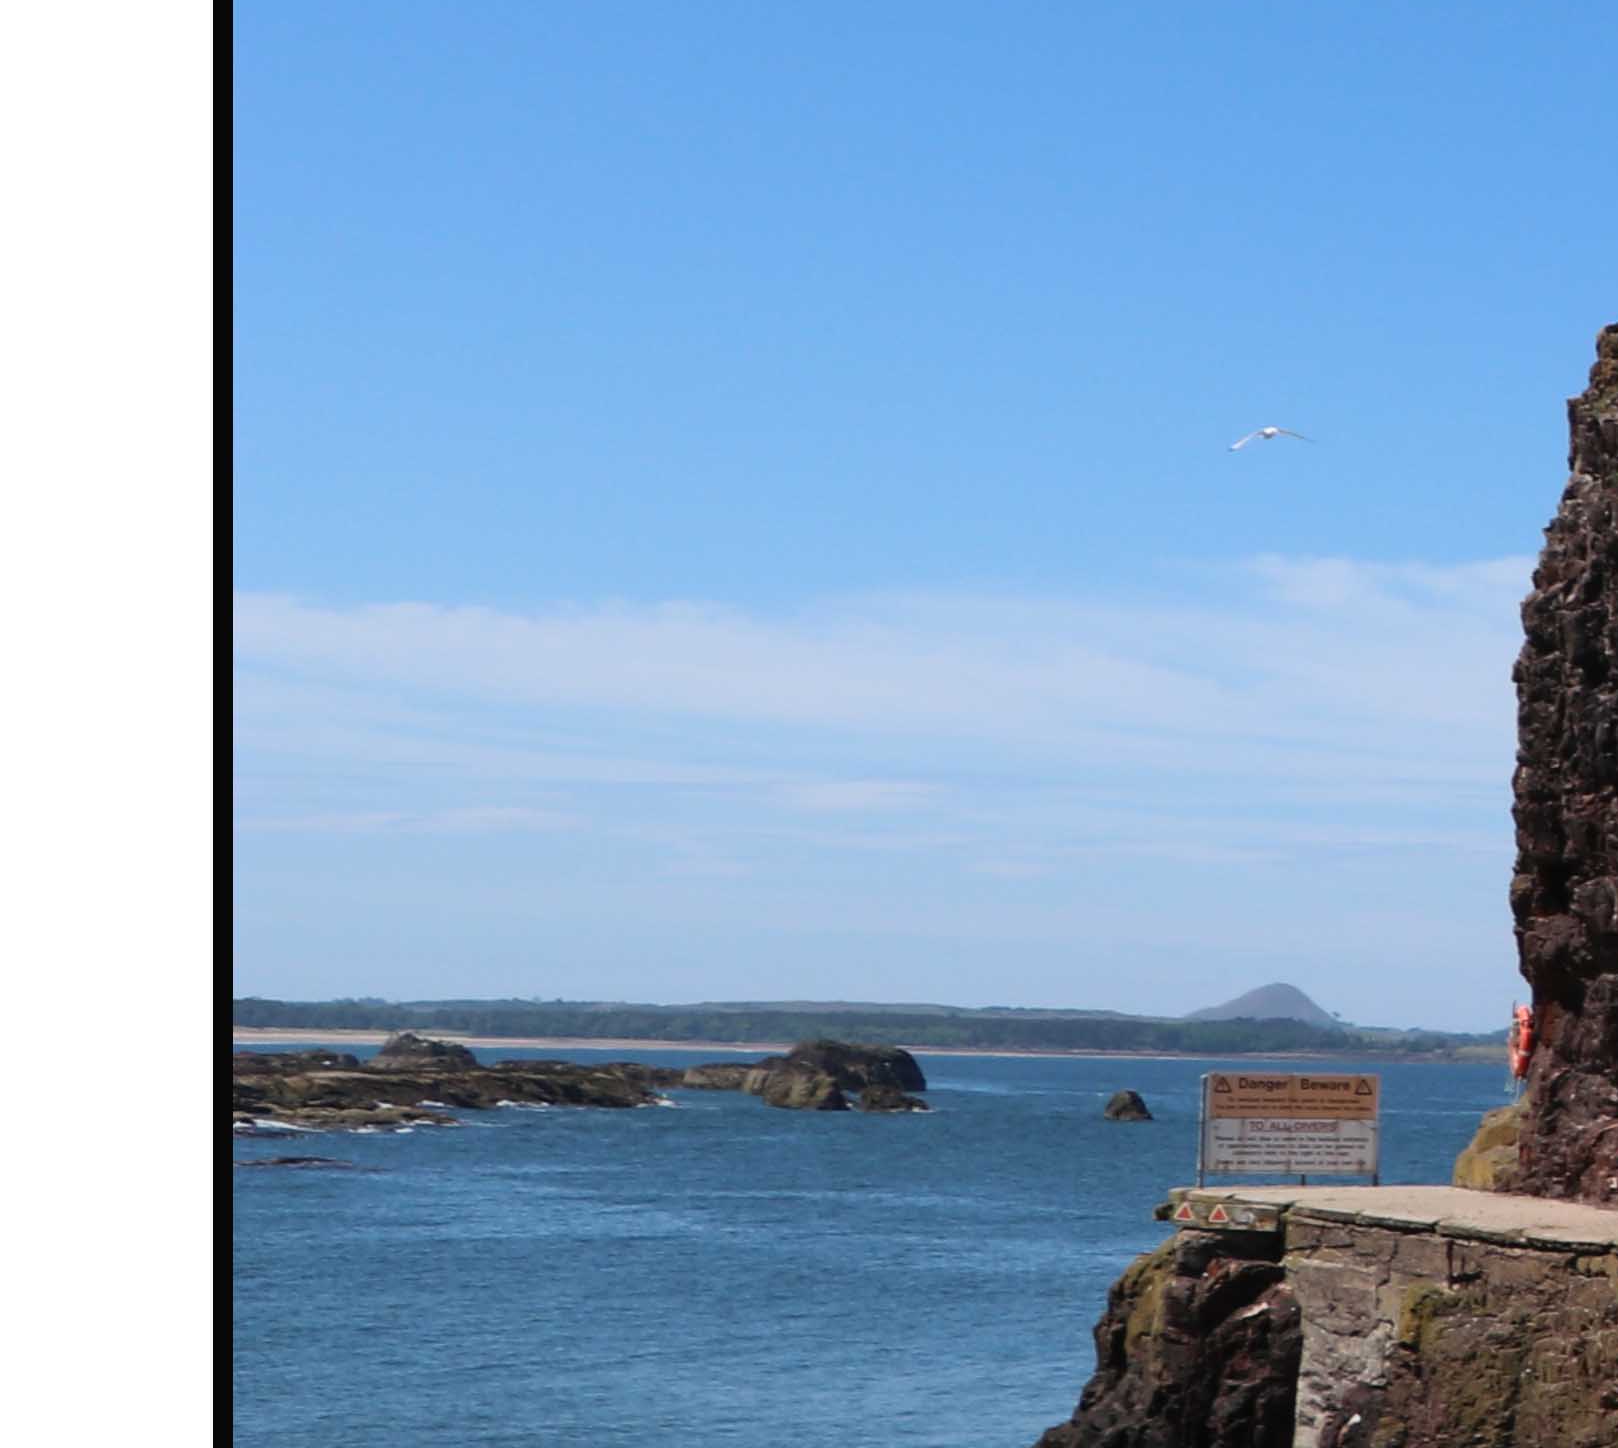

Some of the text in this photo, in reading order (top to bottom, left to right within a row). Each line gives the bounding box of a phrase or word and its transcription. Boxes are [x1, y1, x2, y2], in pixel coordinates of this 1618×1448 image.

[1238, 1077, 1350, 1092] Danger Beware
[1249, 1121, 1264, 1131] TO
